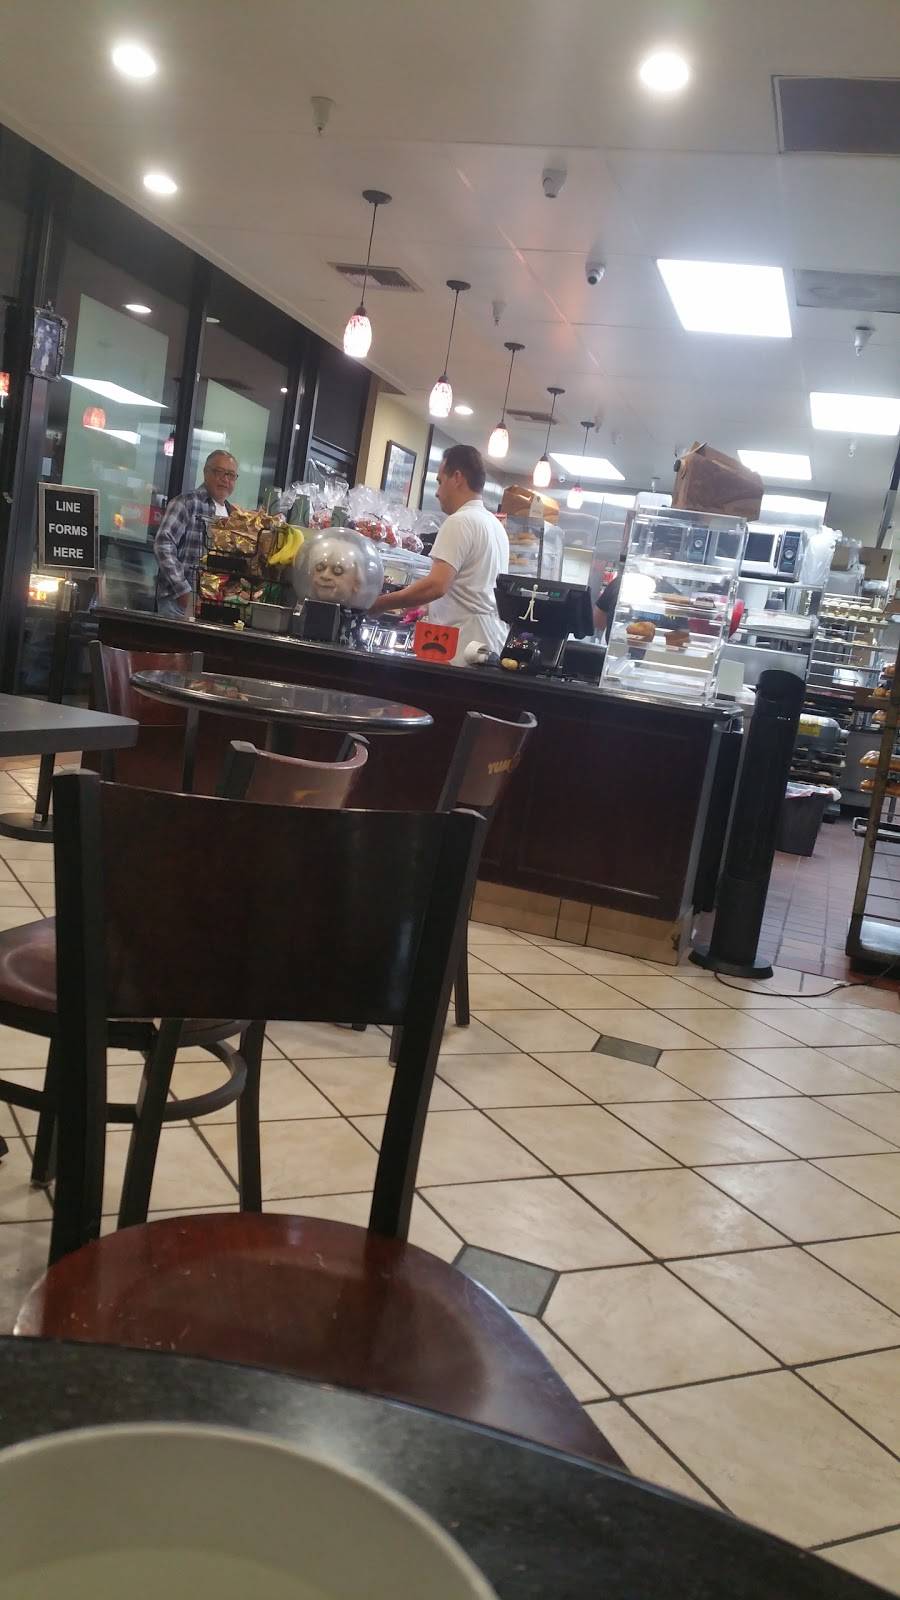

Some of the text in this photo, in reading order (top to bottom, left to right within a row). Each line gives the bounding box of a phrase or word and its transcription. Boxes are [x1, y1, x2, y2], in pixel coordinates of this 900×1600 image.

[56, 501, 81, 513] LINE
[49, 523, 88, 537] FORMS
[53, 546, 84, 559] HERE
